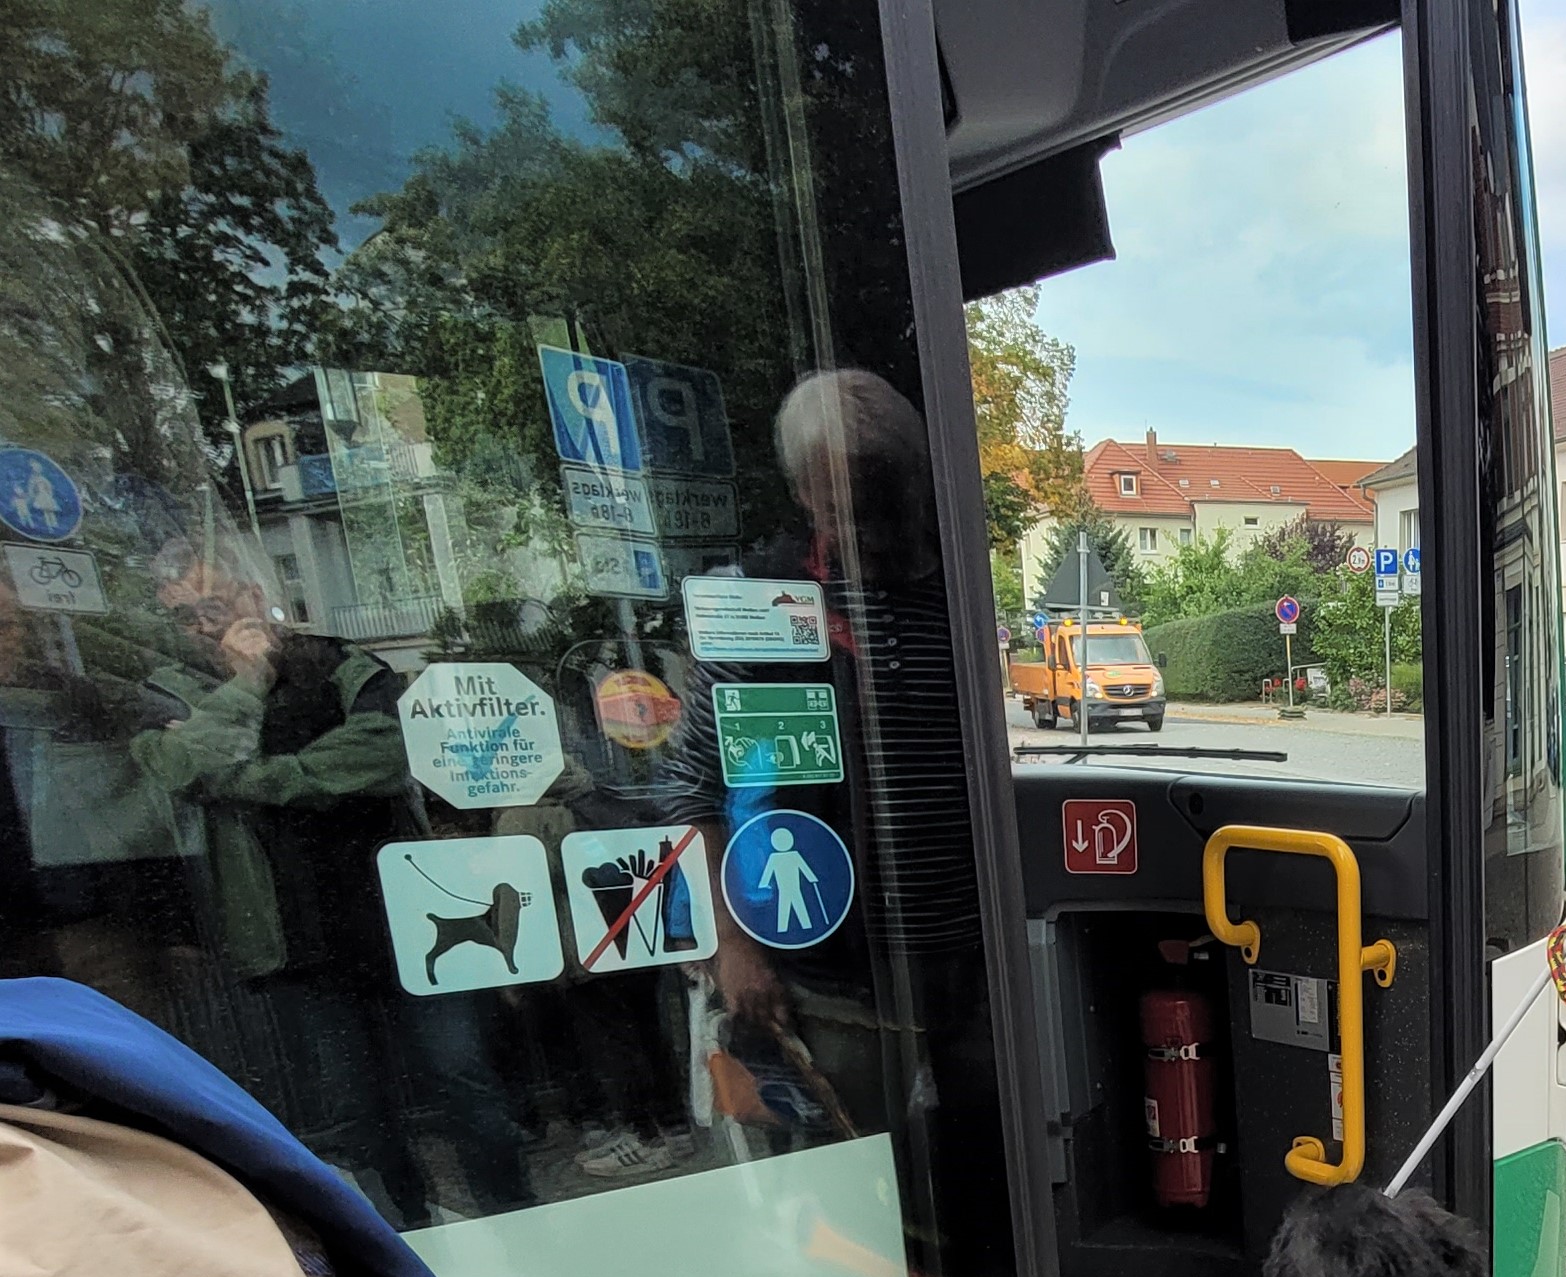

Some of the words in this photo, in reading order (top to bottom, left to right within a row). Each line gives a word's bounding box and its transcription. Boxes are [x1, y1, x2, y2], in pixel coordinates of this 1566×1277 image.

[1380, 552, 1393, 572] P
[454, 675, 498, 696] Mit
[410, 696, 546, 719] Aktivfilter.
[447, 726, 521, 739] Antivirale
[734, 722, 741, 731] 1
[778, 721, 786, 730] 2
[820, 720, 827, 729] 3
[440, 739, 509, 754] Funktion
[512, 739, 536, 752] für
[471, 753, 544, 770] geringere
[467, 781, 521, 798] gefahr.
